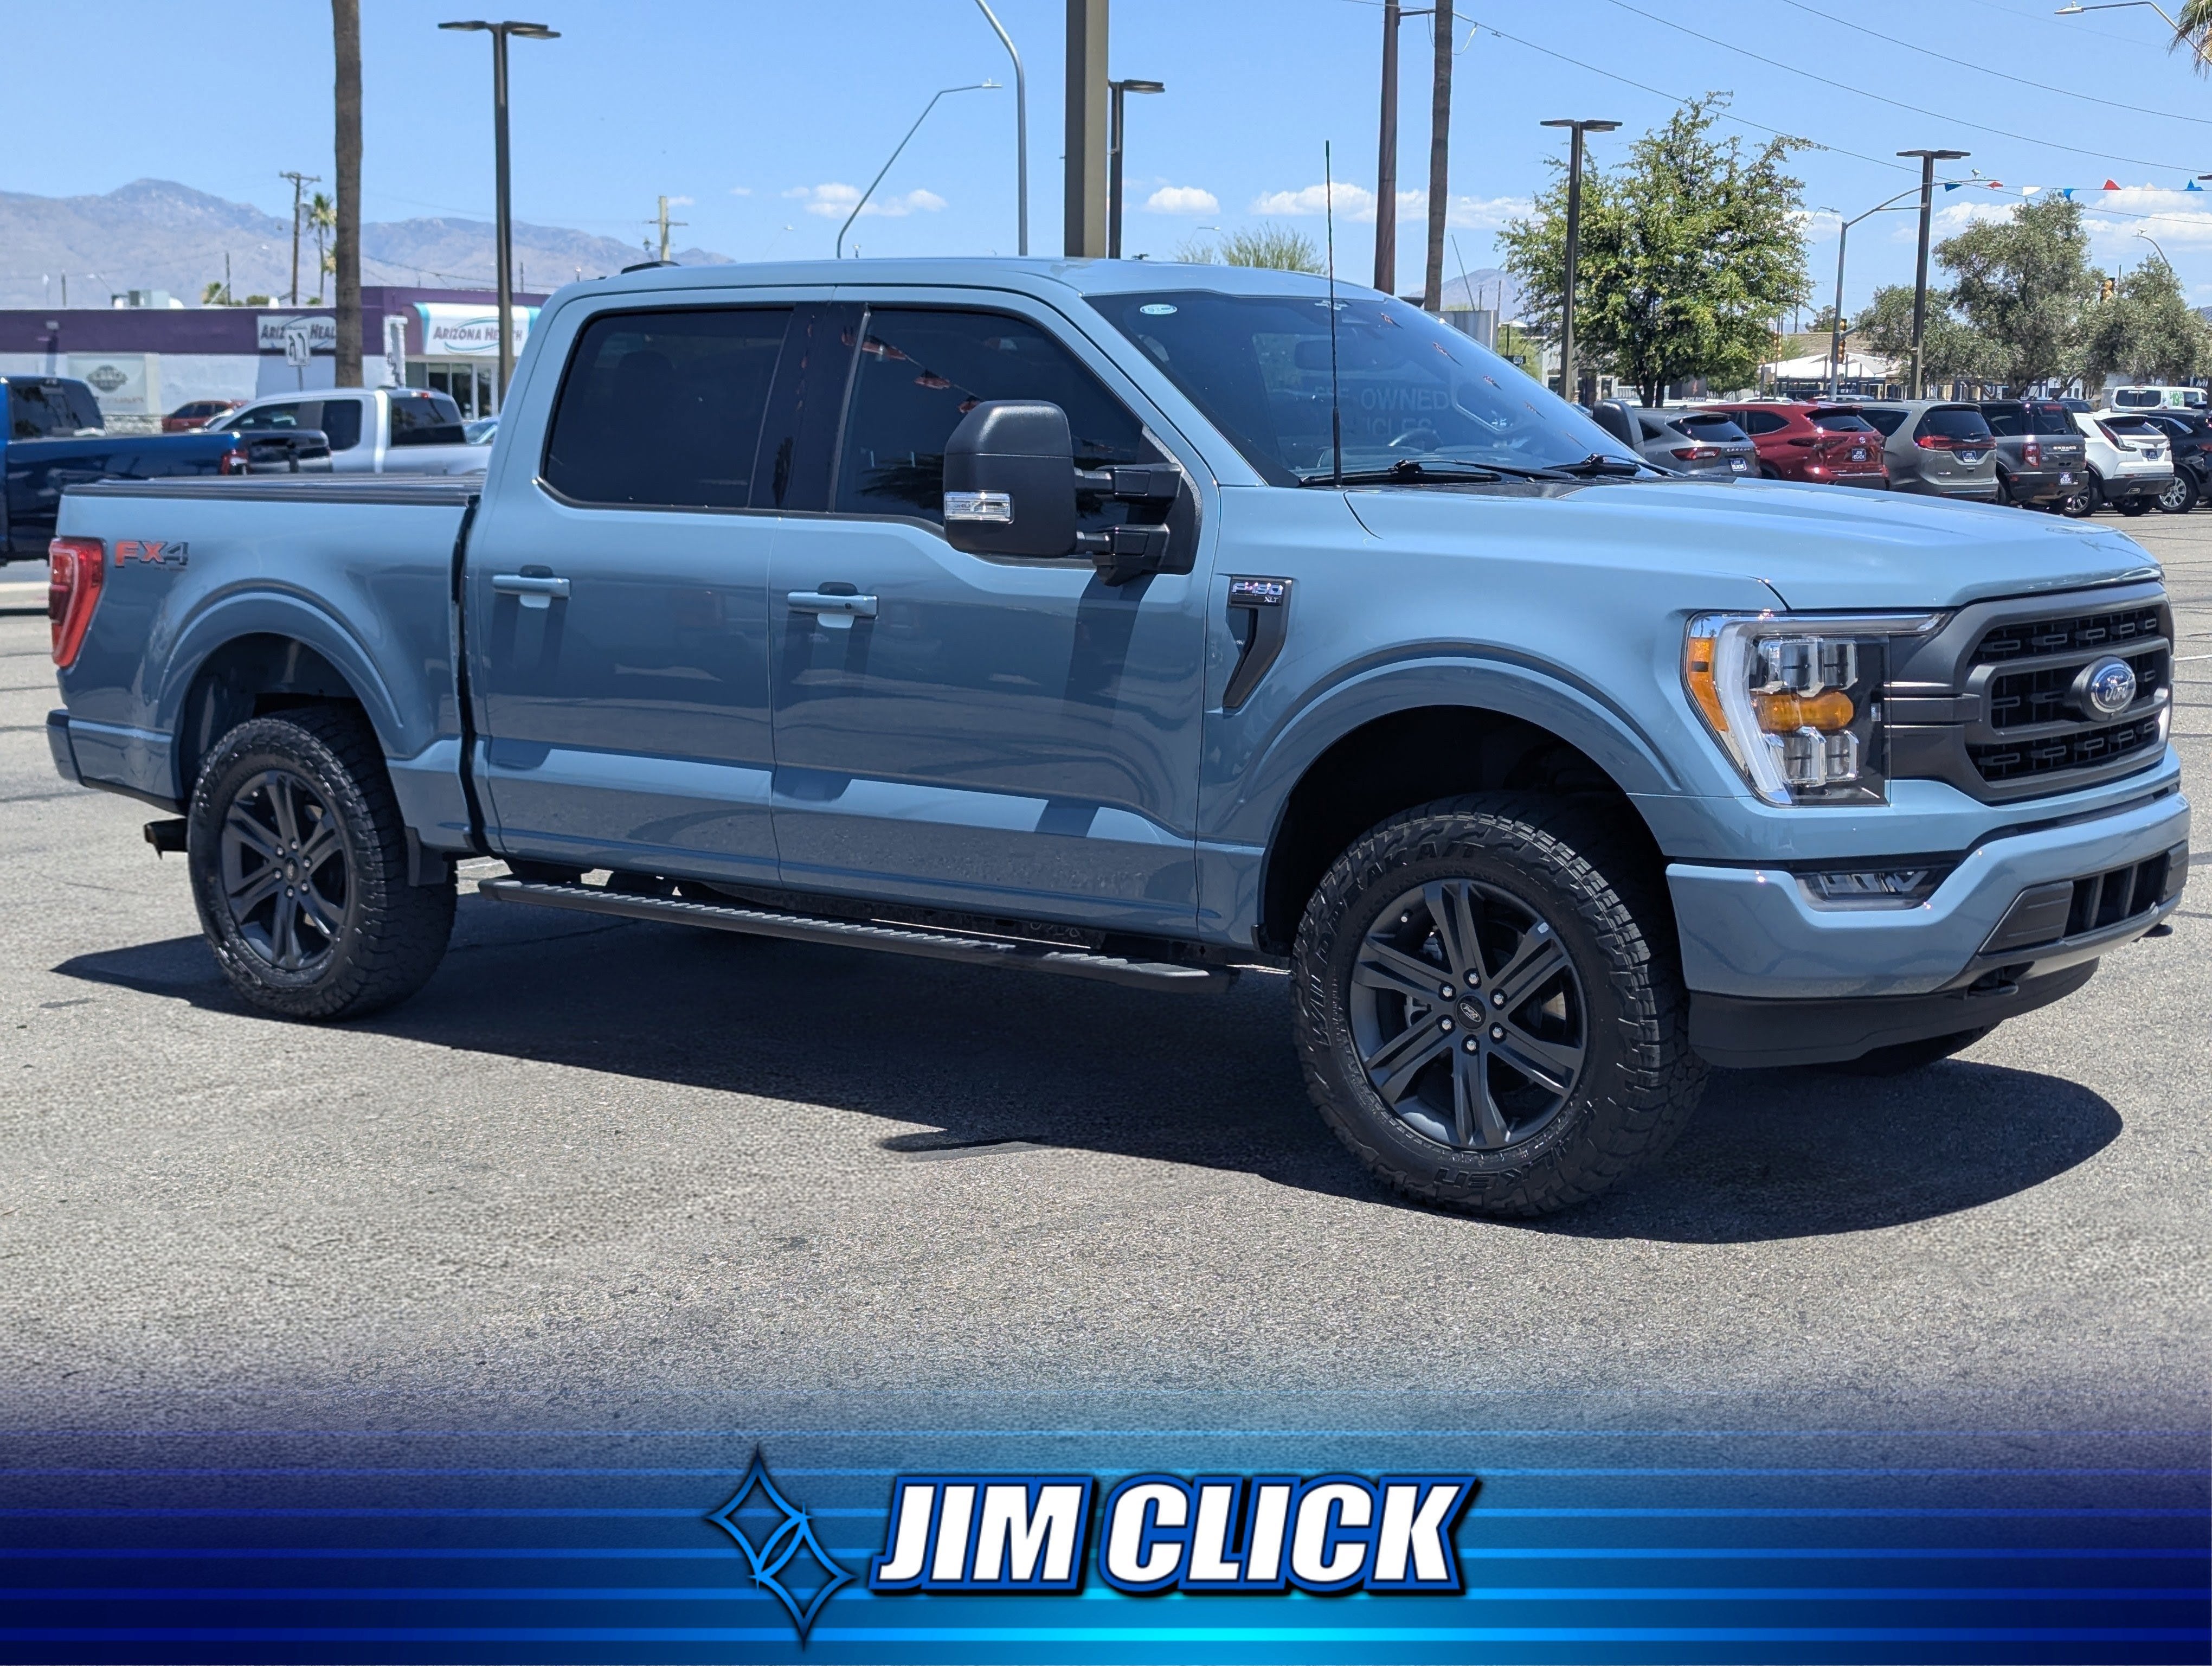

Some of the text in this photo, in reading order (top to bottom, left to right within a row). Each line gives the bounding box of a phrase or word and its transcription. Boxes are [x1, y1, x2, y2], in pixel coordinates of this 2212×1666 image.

[433, 326, 523, 341] ARIZONA HETH
[1361, 388, 1449, 411] OWNED
[114, 540, 189, 568] FX4
[1232, 581, 1283, 595] F-150
[2105, 675, 2129, 702] Ford
